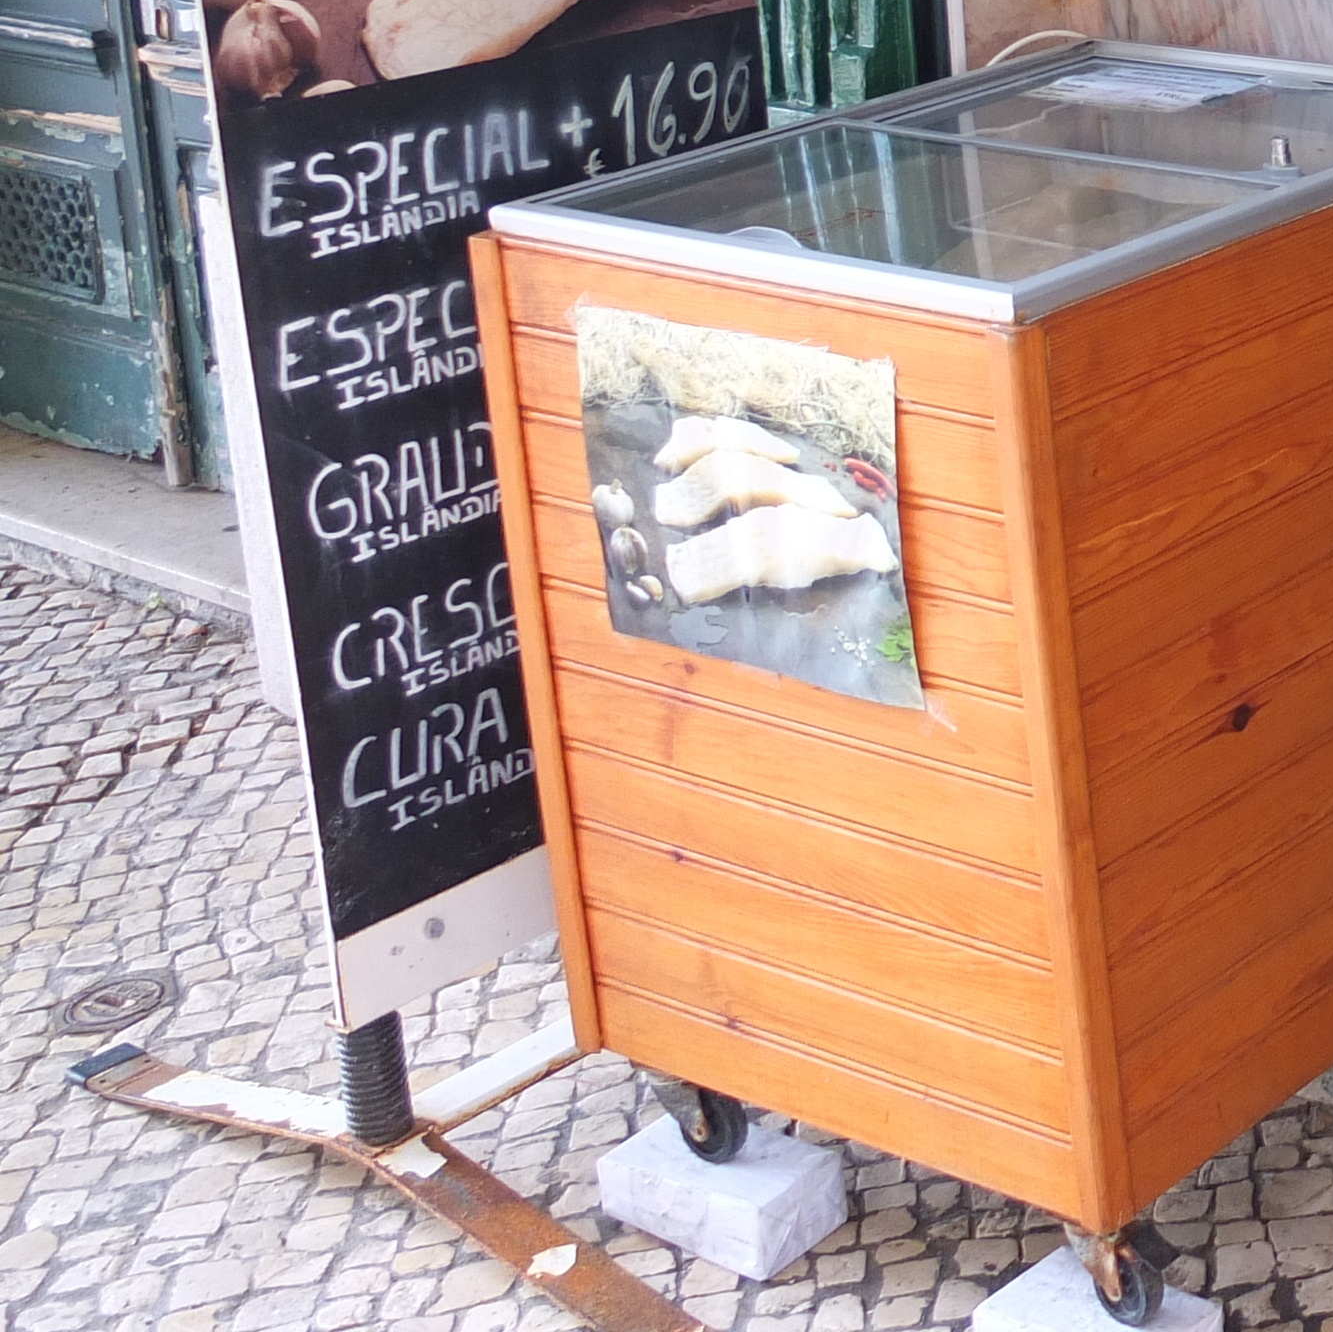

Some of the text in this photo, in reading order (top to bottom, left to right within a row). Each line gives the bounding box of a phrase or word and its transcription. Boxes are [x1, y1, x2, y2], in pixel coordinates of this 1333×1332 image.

[260, 57, 752, 241] ESPECIAL + 16.90
[309, 186, 482, 260] ISLÂNDIA
[279, 279, 477, 392] ESPEC
[342, 685, 511, 810] CURA
